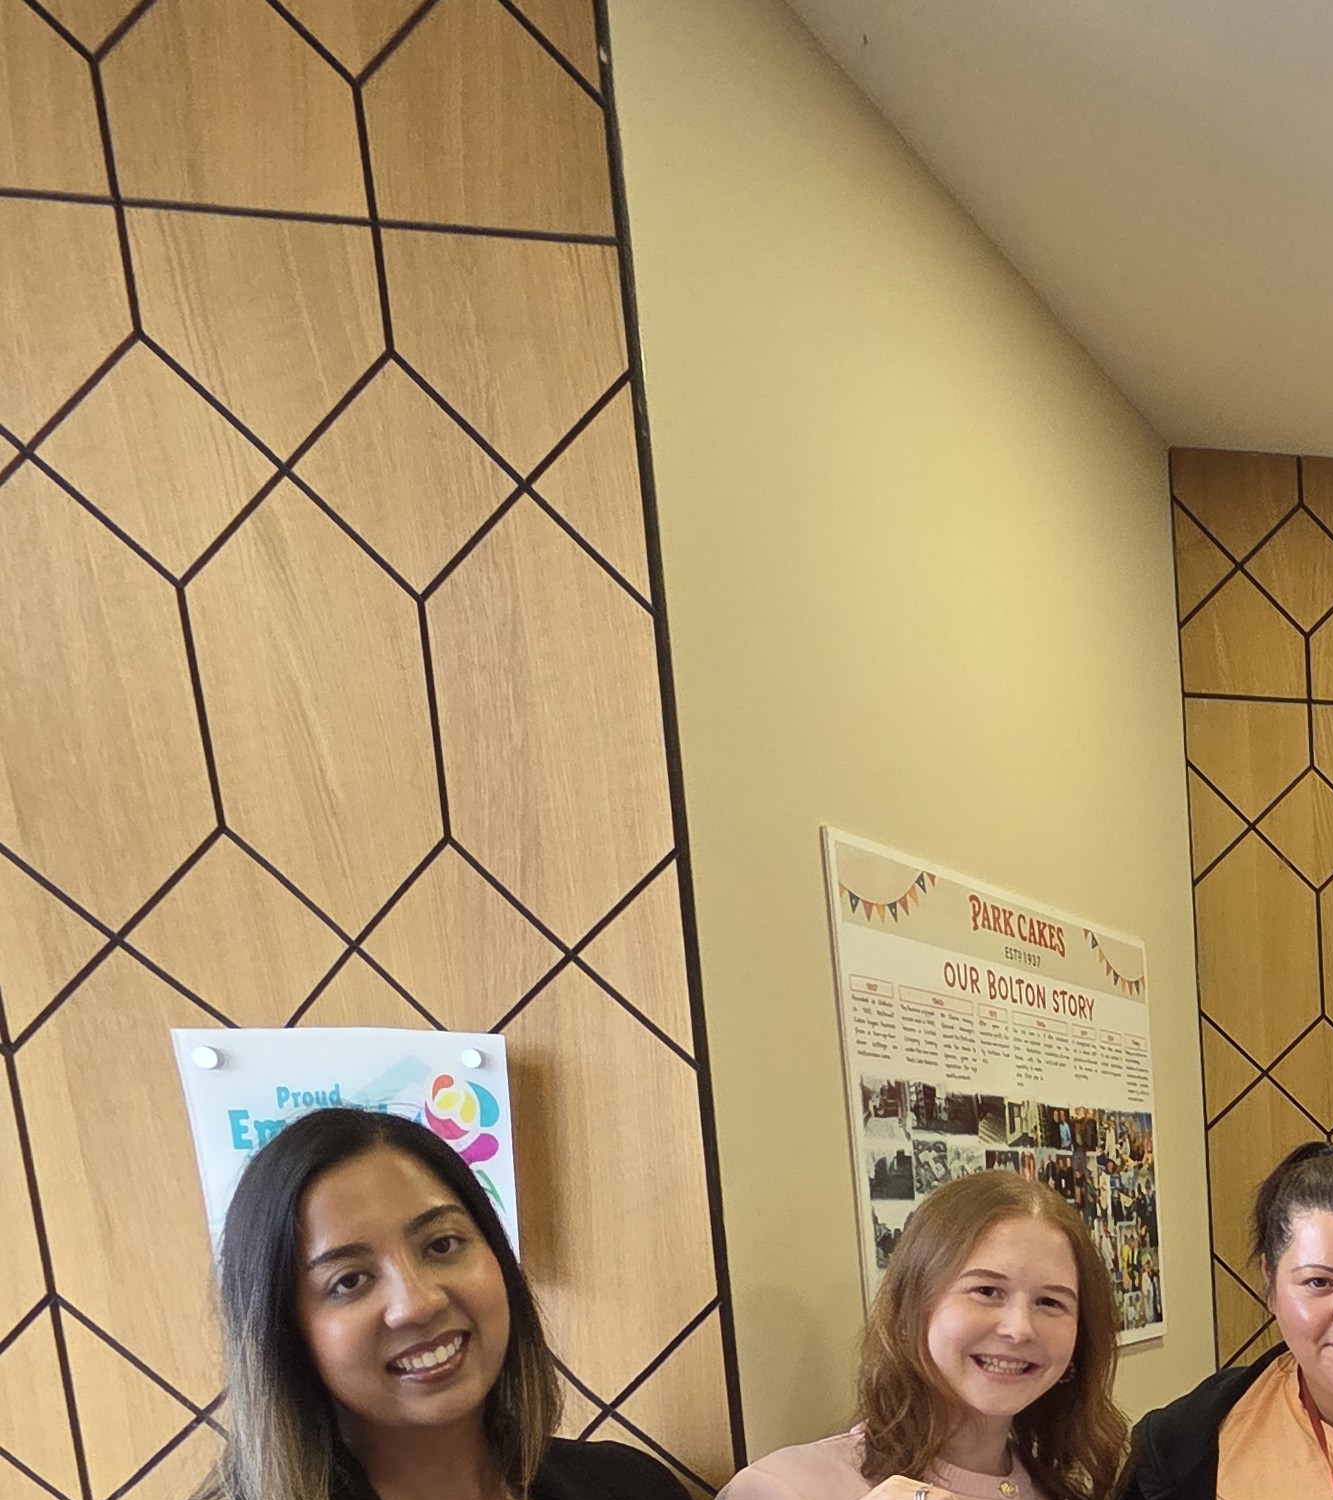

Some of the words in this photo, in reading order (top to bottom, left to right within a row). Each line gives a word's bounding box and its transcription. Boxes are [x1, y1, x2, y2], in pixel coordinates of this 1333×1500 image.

[969, 894, 1015, 938] PARK
[1018, 914, 1065, 957] CAKES
[944, 961, 980, 994] OUR
[987, 969, 1046, 1009] BOLTON
[1052, 990, 1095, 1021] STORY
[276, 1083, 342, 1109] Proud
